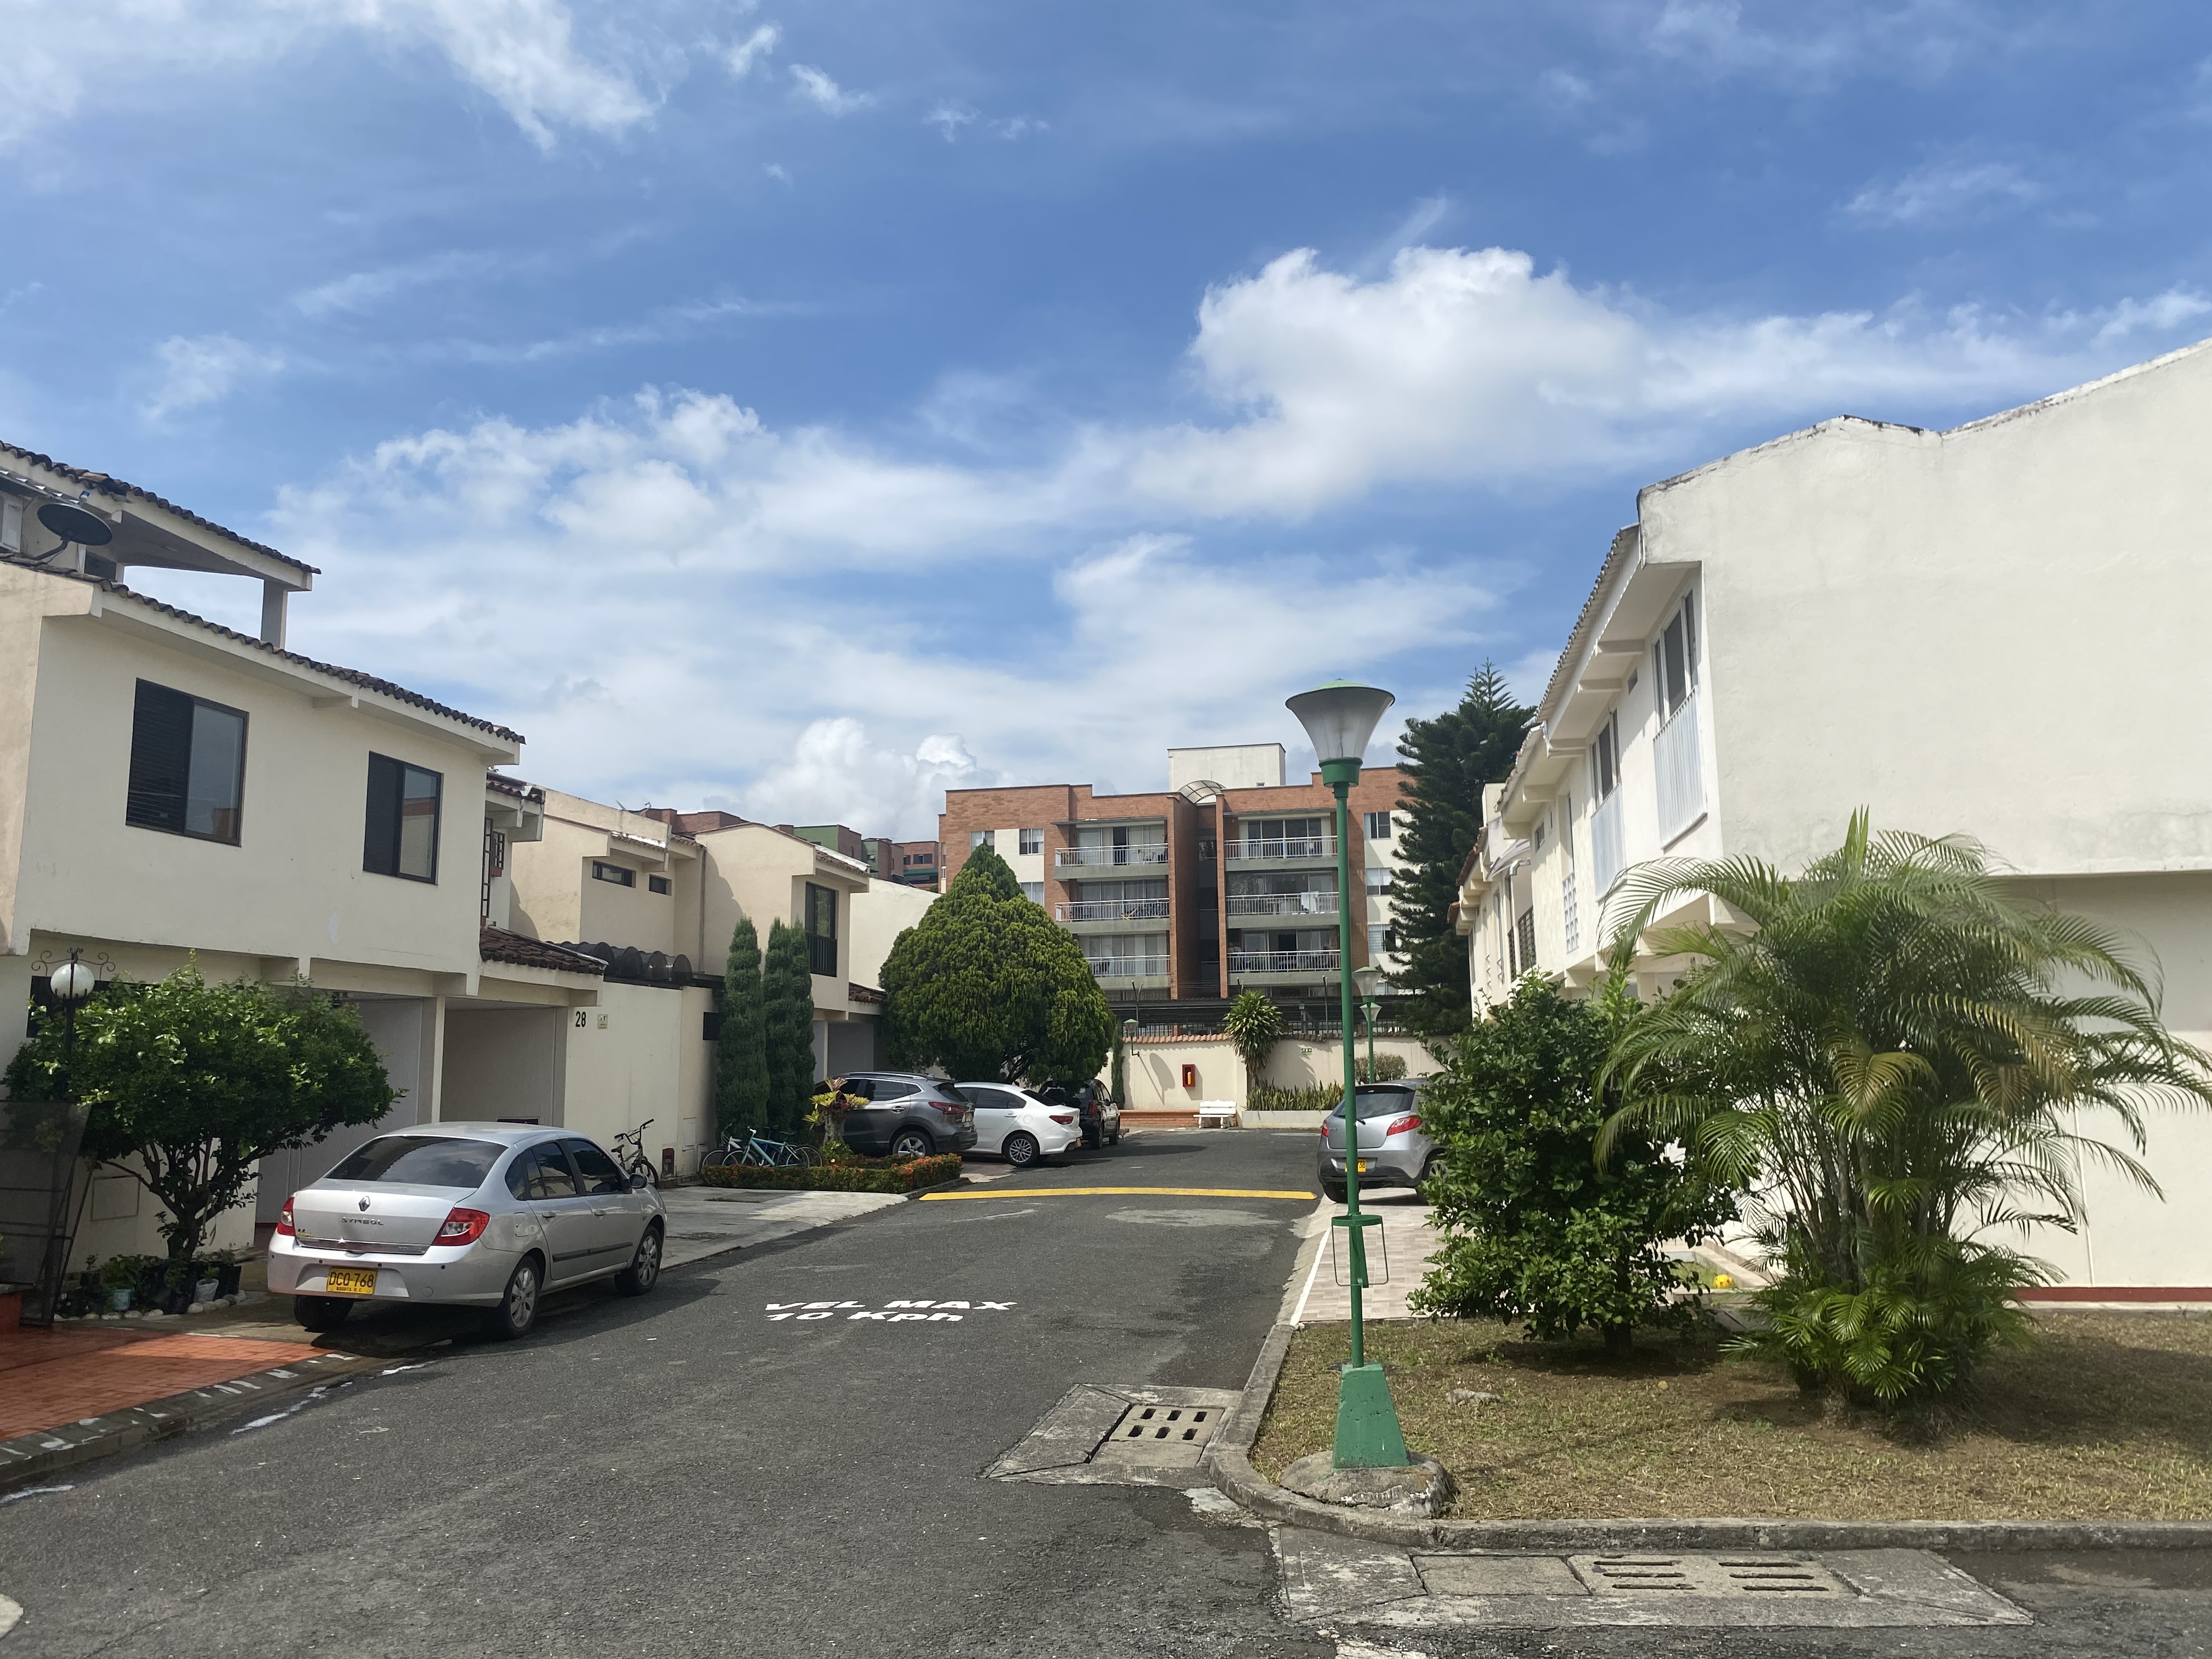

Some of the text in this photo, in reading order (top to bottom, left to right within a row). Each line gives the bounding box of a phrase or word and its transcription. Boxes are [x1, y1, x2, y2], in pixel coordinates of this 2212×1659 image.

[575, 1011, 586, 1028] 28
[341, 1216, 384, 1226] SYMBOL
[765, 1300, 1018, 1311] VEL MAX
[765, 1311, 963, 1322] 10 Kph
